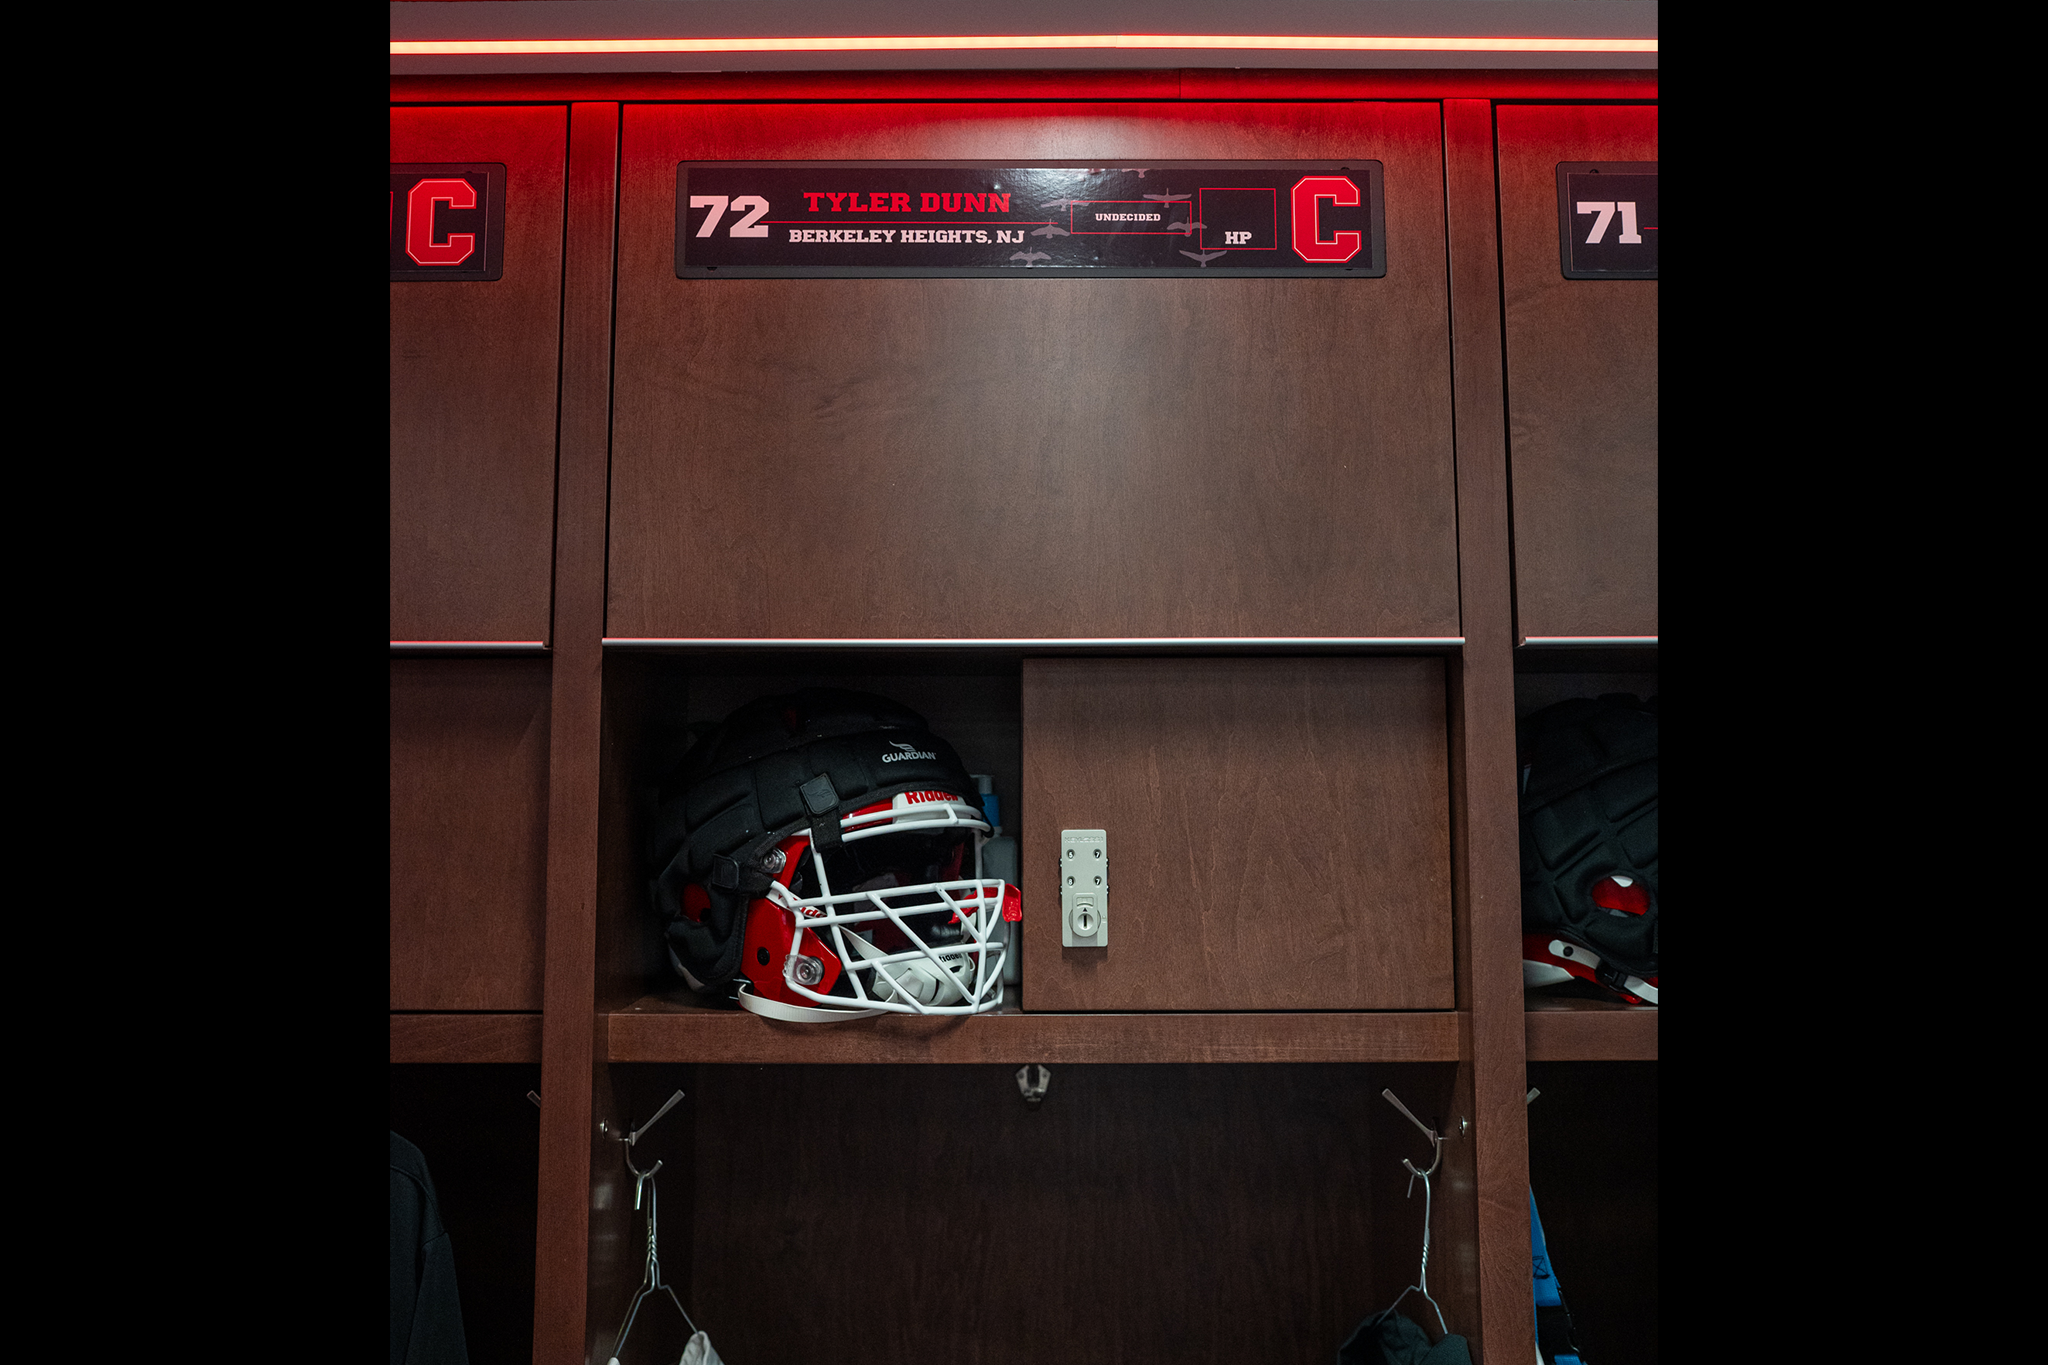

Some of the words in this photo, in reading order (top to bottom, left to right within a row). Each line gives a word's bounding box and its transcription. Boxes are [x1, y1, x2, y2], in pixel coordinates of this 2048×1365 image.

[803, 192, 912, 213] TYLER
[920, 192, 1012, 213] DUNN
[405, 178, 477, 266] C
[689, 195, 770, 238] 72
[1095, 213, 1161, 222] UNDECIDED
[1291, 176, 1362, 263] C
[1576, 201, 1642, 244] 71
[789, 229, 896, 243] BERKELEY
[900, 229, 992, 245] HEIGHTS,
[996, 230, 1025, 244] NJ
[1224, 231, 1252, 245] HP
[881, 751, 936, 763] GUARDIAN
